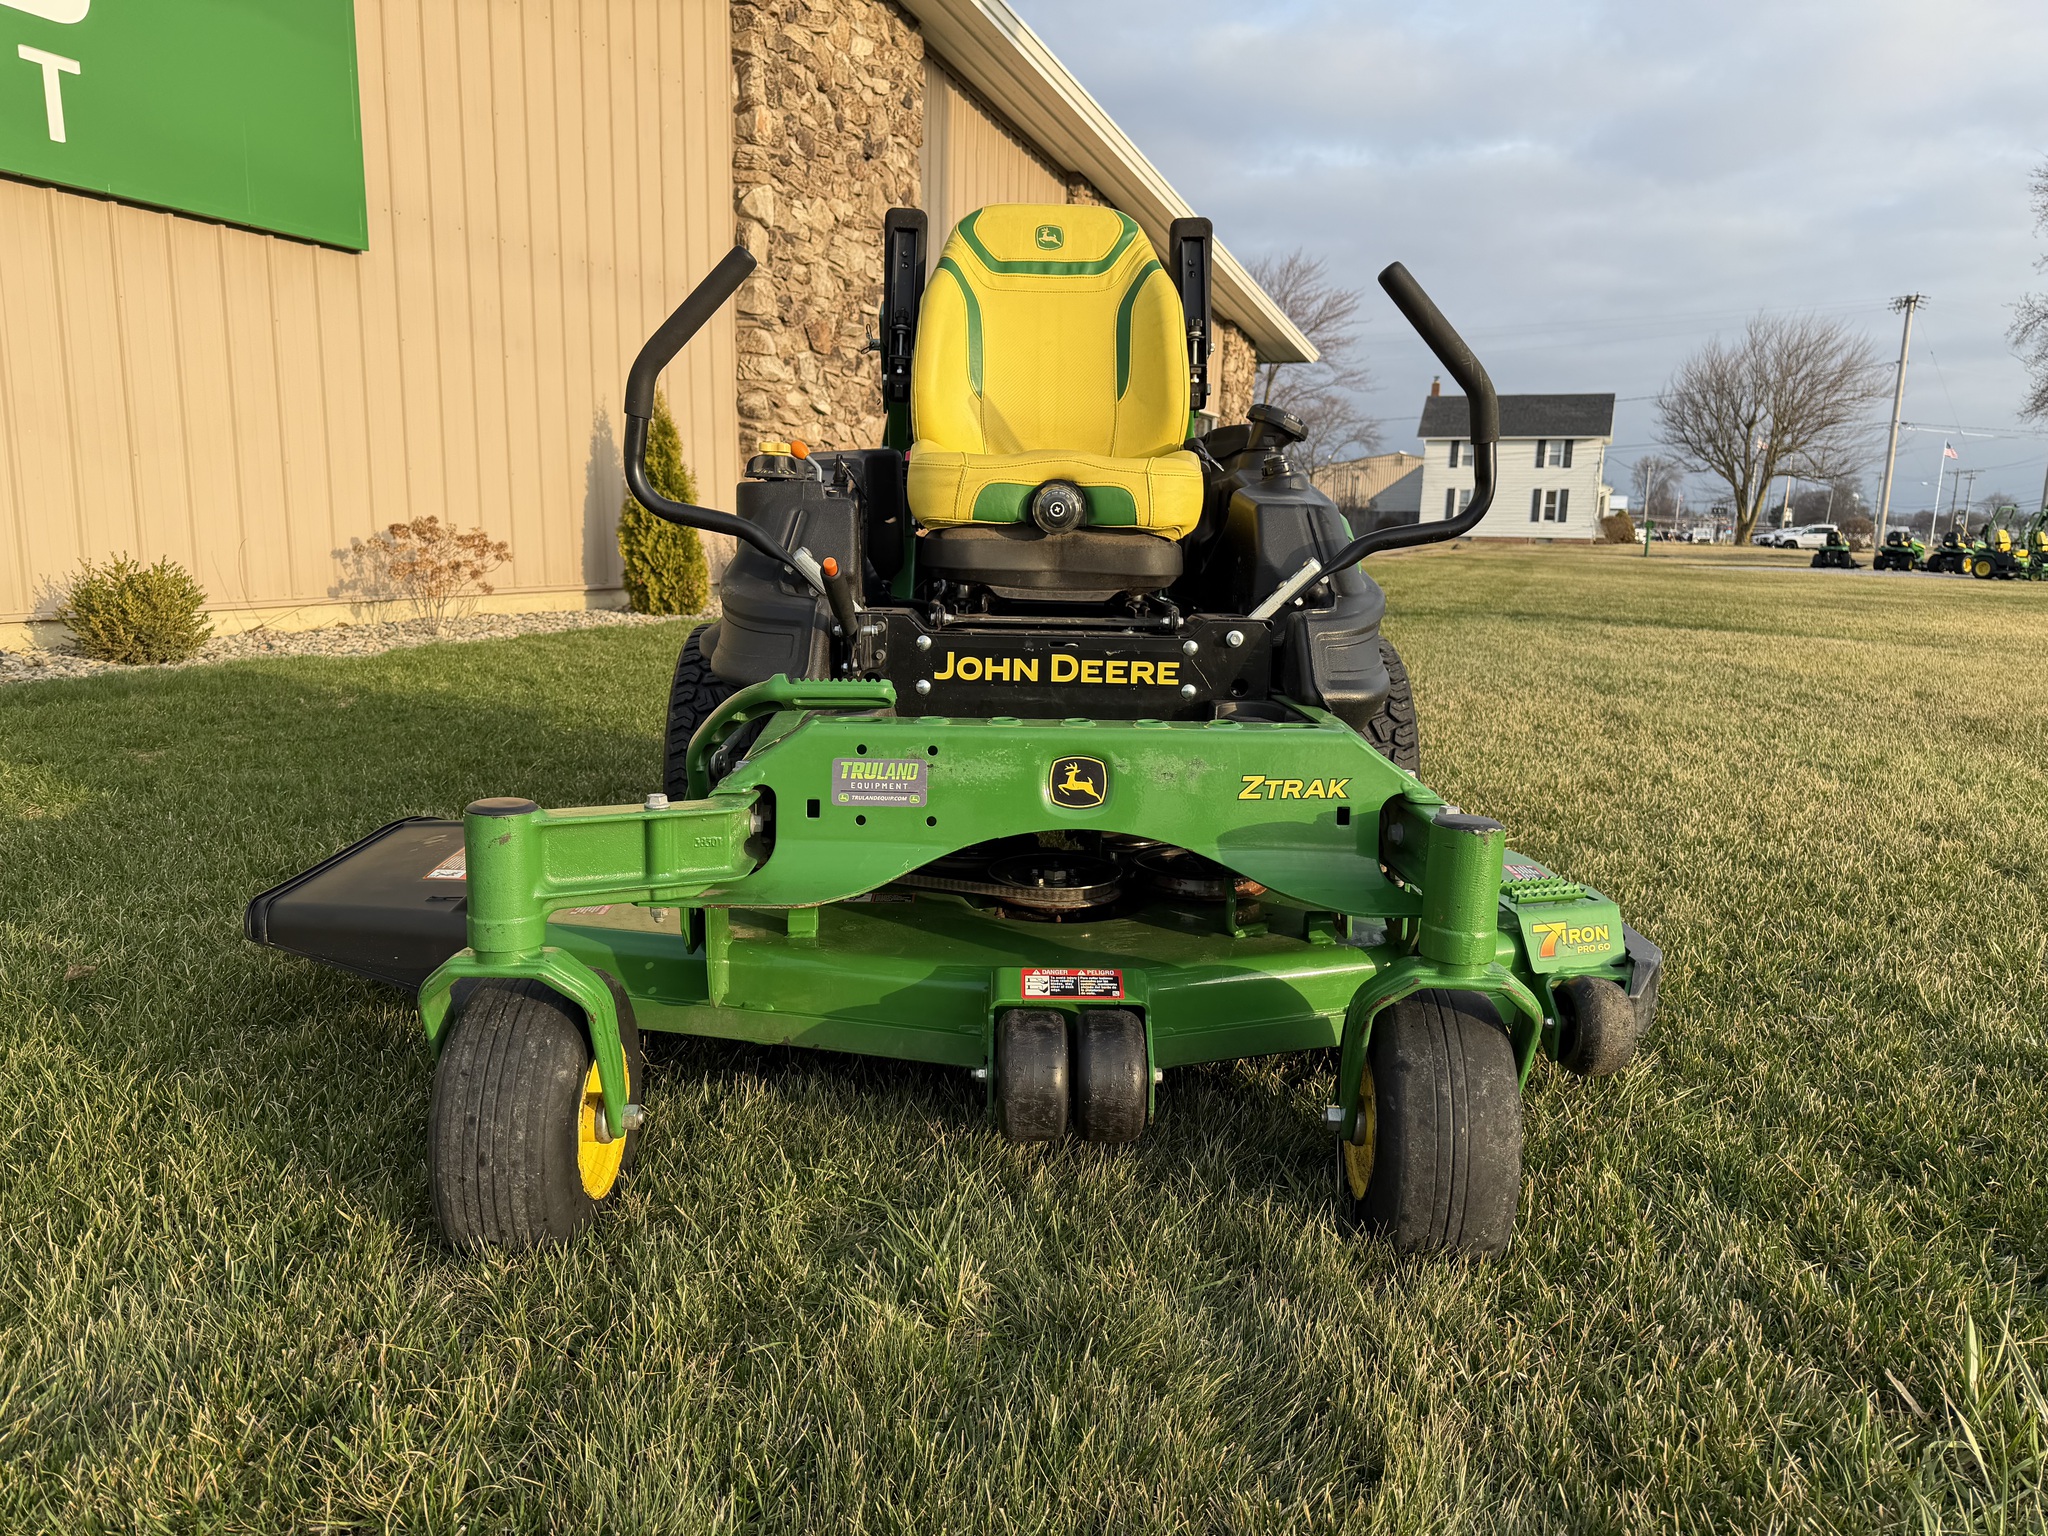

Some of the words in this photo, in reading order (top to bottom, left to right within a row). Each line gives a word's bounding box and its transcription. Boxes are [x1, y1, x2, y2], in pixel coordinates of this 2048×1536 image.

[17, 43, 81, 144] T
[933, 651, 1039, 682] JOHN
[1050, 653, 1180, 685] DEERE
[840, 761, 919, 781] TRULAND
[850, 781, 908, 790] EQUIPMENT
[1237, 774, 1352, 800] ZTRAK
[851, 794, 908, 802] TRULANDEQUIP.COM
[1577, 944, 1596, 954] PRO
[1598, 943, 1611, 951] 60
